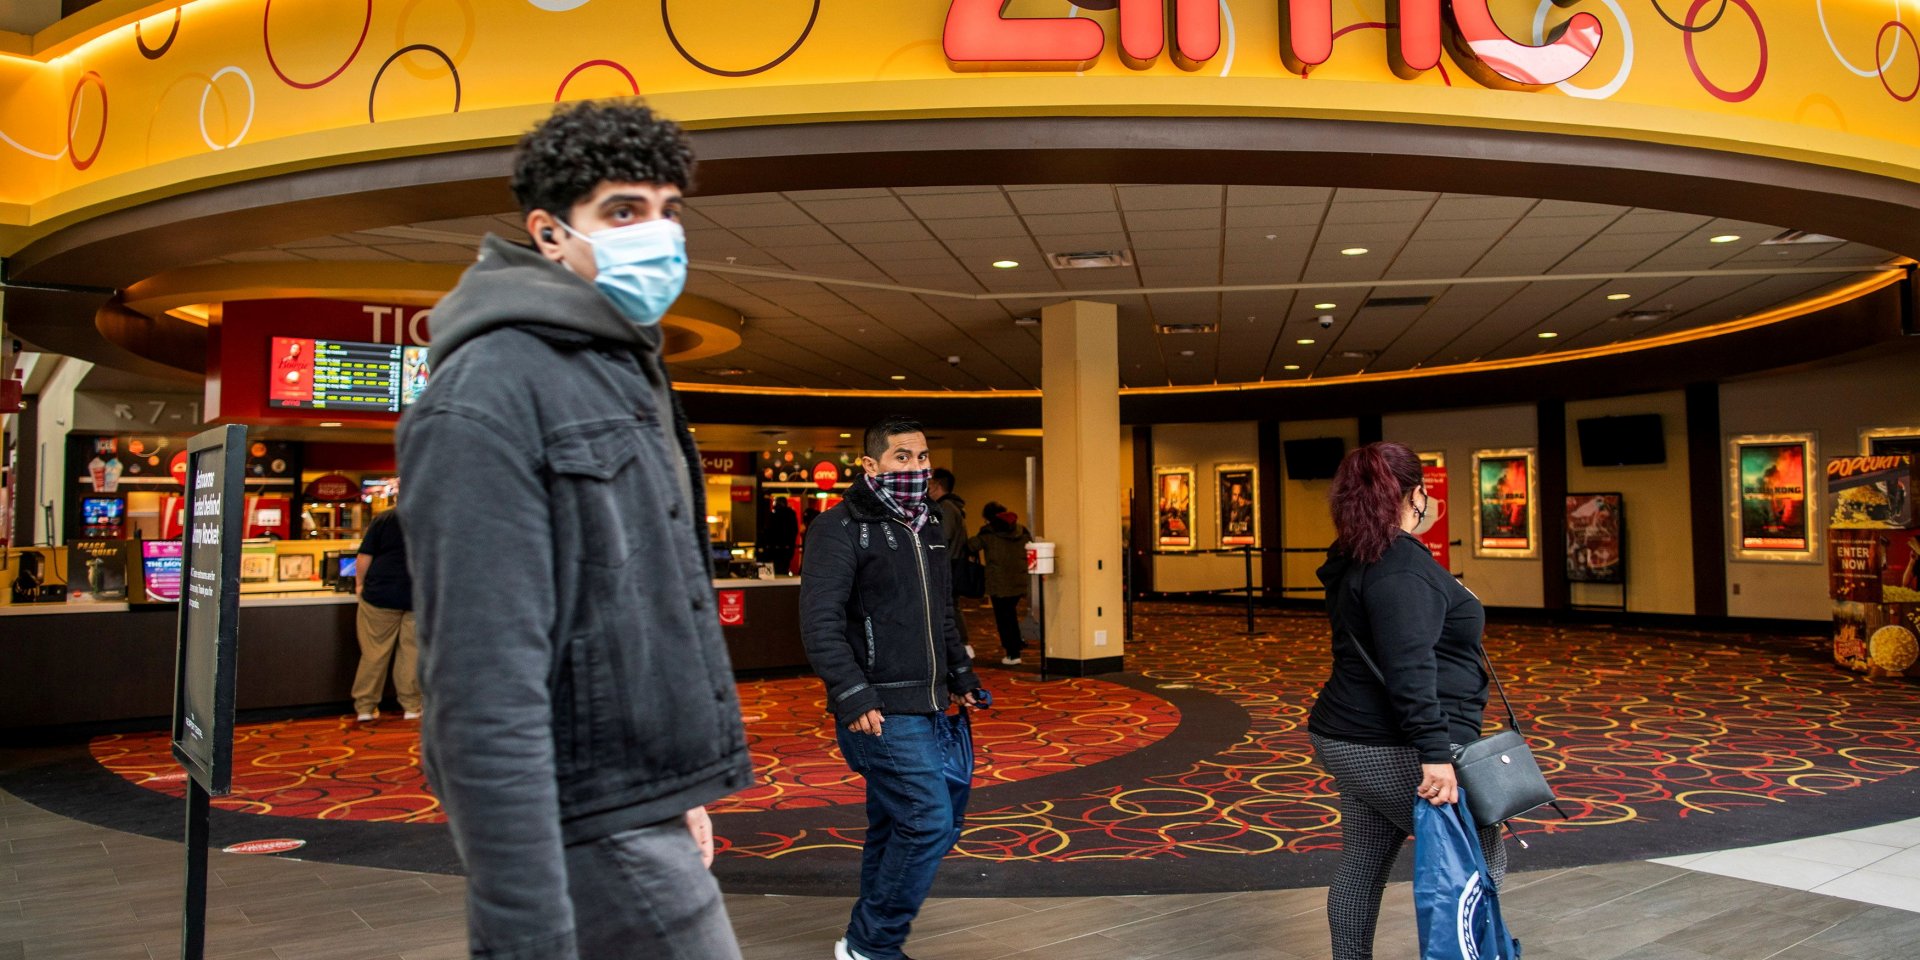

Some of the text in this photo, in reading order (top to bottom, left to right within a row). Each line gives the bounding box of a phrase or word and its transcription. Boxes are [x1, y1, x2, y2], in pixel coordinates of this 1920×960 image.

[814, 470, 837, 480] amc
[1837, 546, 1870, 558] ENTER
[1841, 559, 1866, 571] NOW
